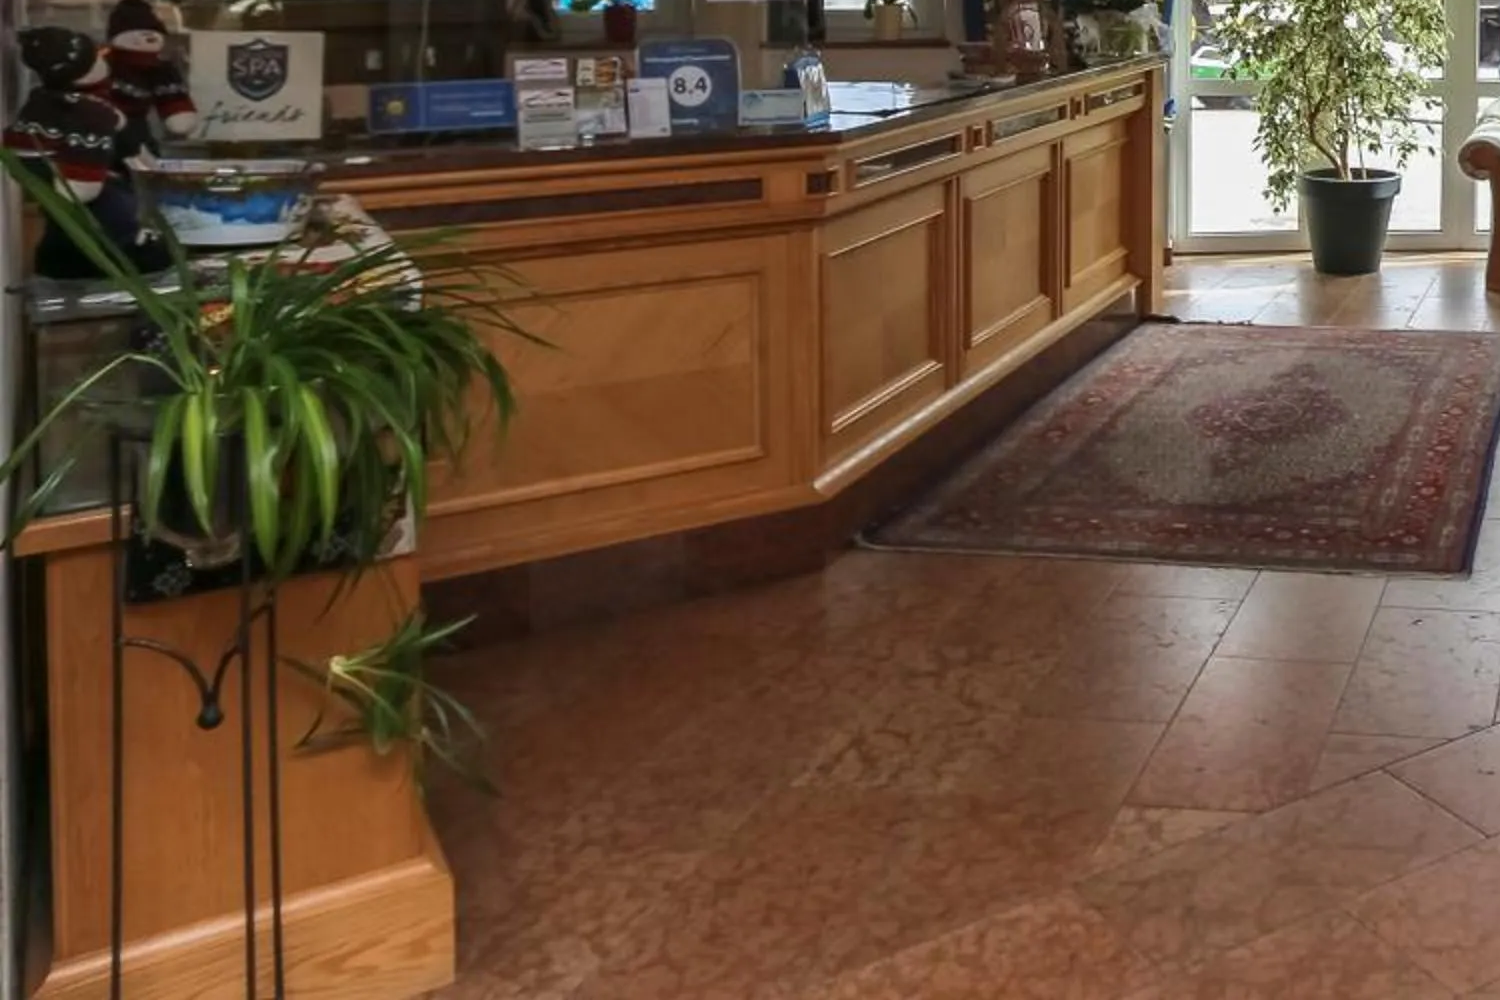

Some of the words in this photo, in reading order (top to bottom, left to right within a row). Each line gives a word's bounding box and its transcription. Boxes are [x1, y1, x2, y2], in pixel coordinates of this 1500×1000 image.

[232, 58, 281, 76] SPA
[673, 77, 707, 95] 8.4
[200, 100, 304, 138] friends
